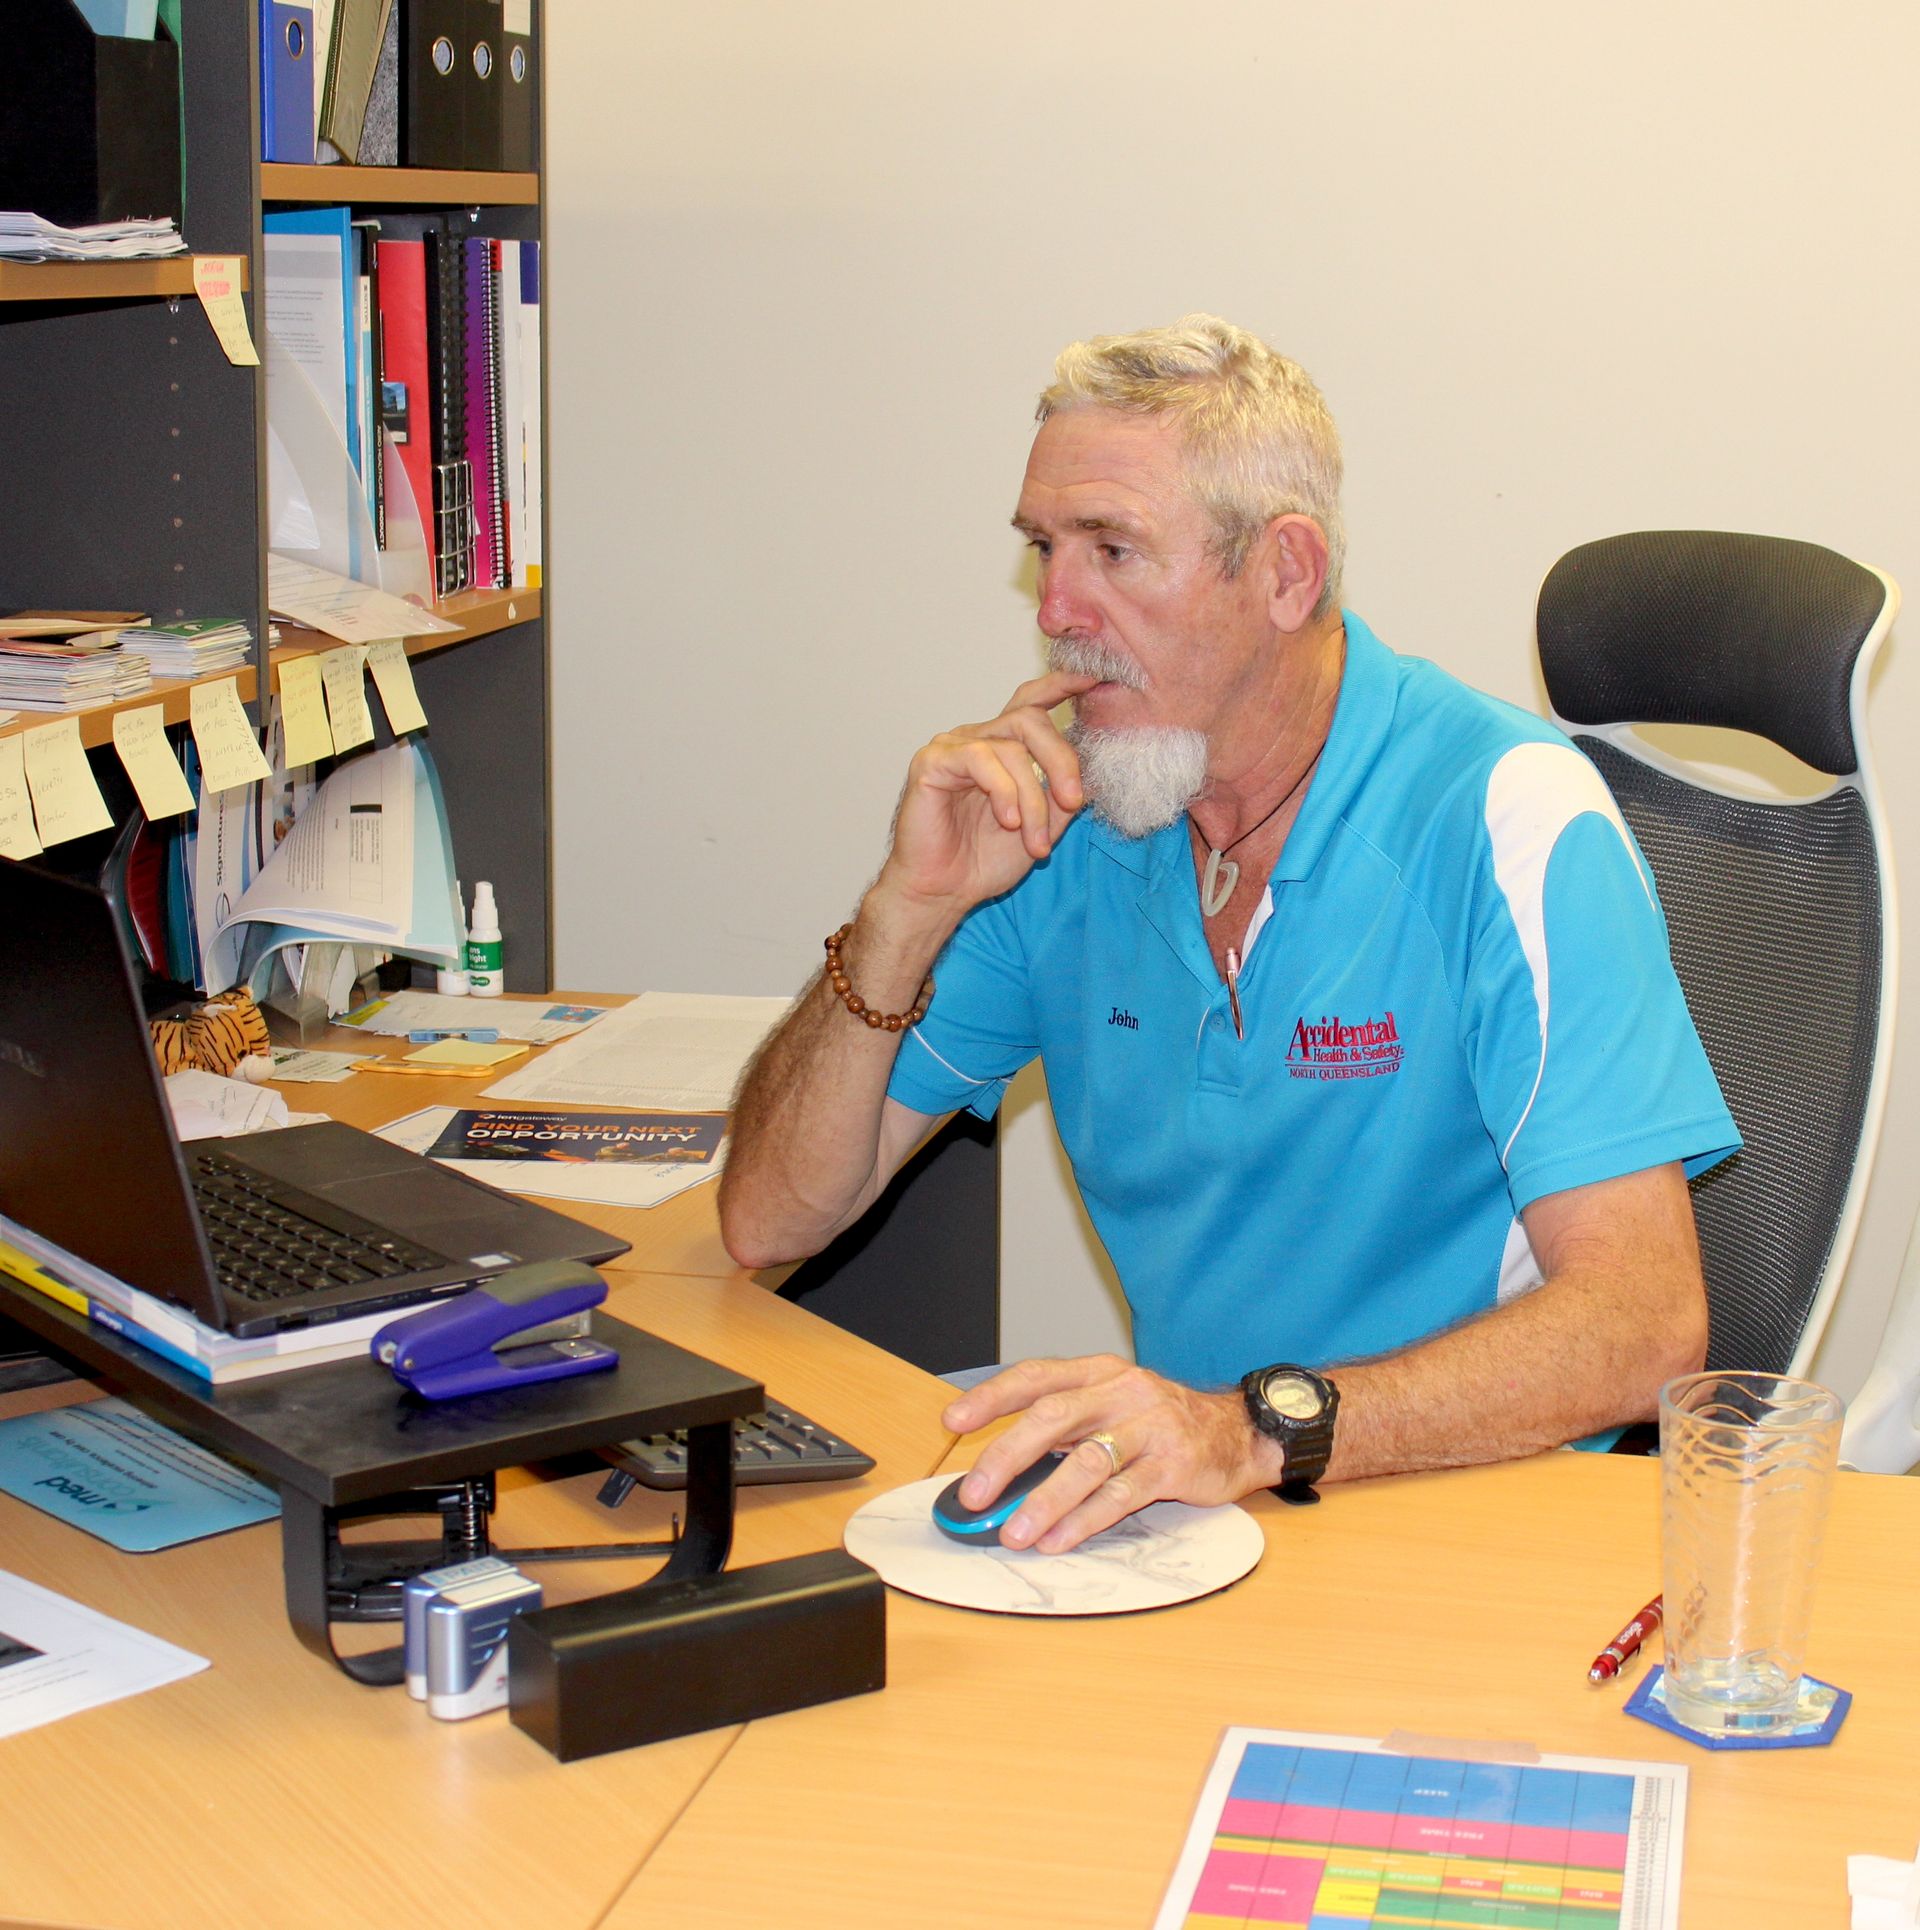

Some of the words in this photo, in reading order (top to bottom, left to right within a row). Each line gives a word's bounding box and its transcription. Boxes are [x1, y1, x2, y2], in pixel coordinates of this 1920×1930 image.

[1107, 1006, 1139, 1031] John
[1284, 1011, 1401, 1061] Accidental
[1313, 1047, 1349, 1063] Health
[1350, 1046, 1362, 1061] &
[1289, 1068, 1317, 1080] NORTH
[1319, 1062, 1401, 1081] QUEENSLAND
[465, 1128, 698, 1142] OPPORTUNITY
[471, 1121, 536, 1131] FIND
[543, 1123, 621, 1133] YOUR
[627, 1125, 703, 1134] NEXT
[33, 1475, 107, 1505] med
[1420, 1827, 1451, 1838] TIME
[1454, 1830, 1485, 1841] FREE
